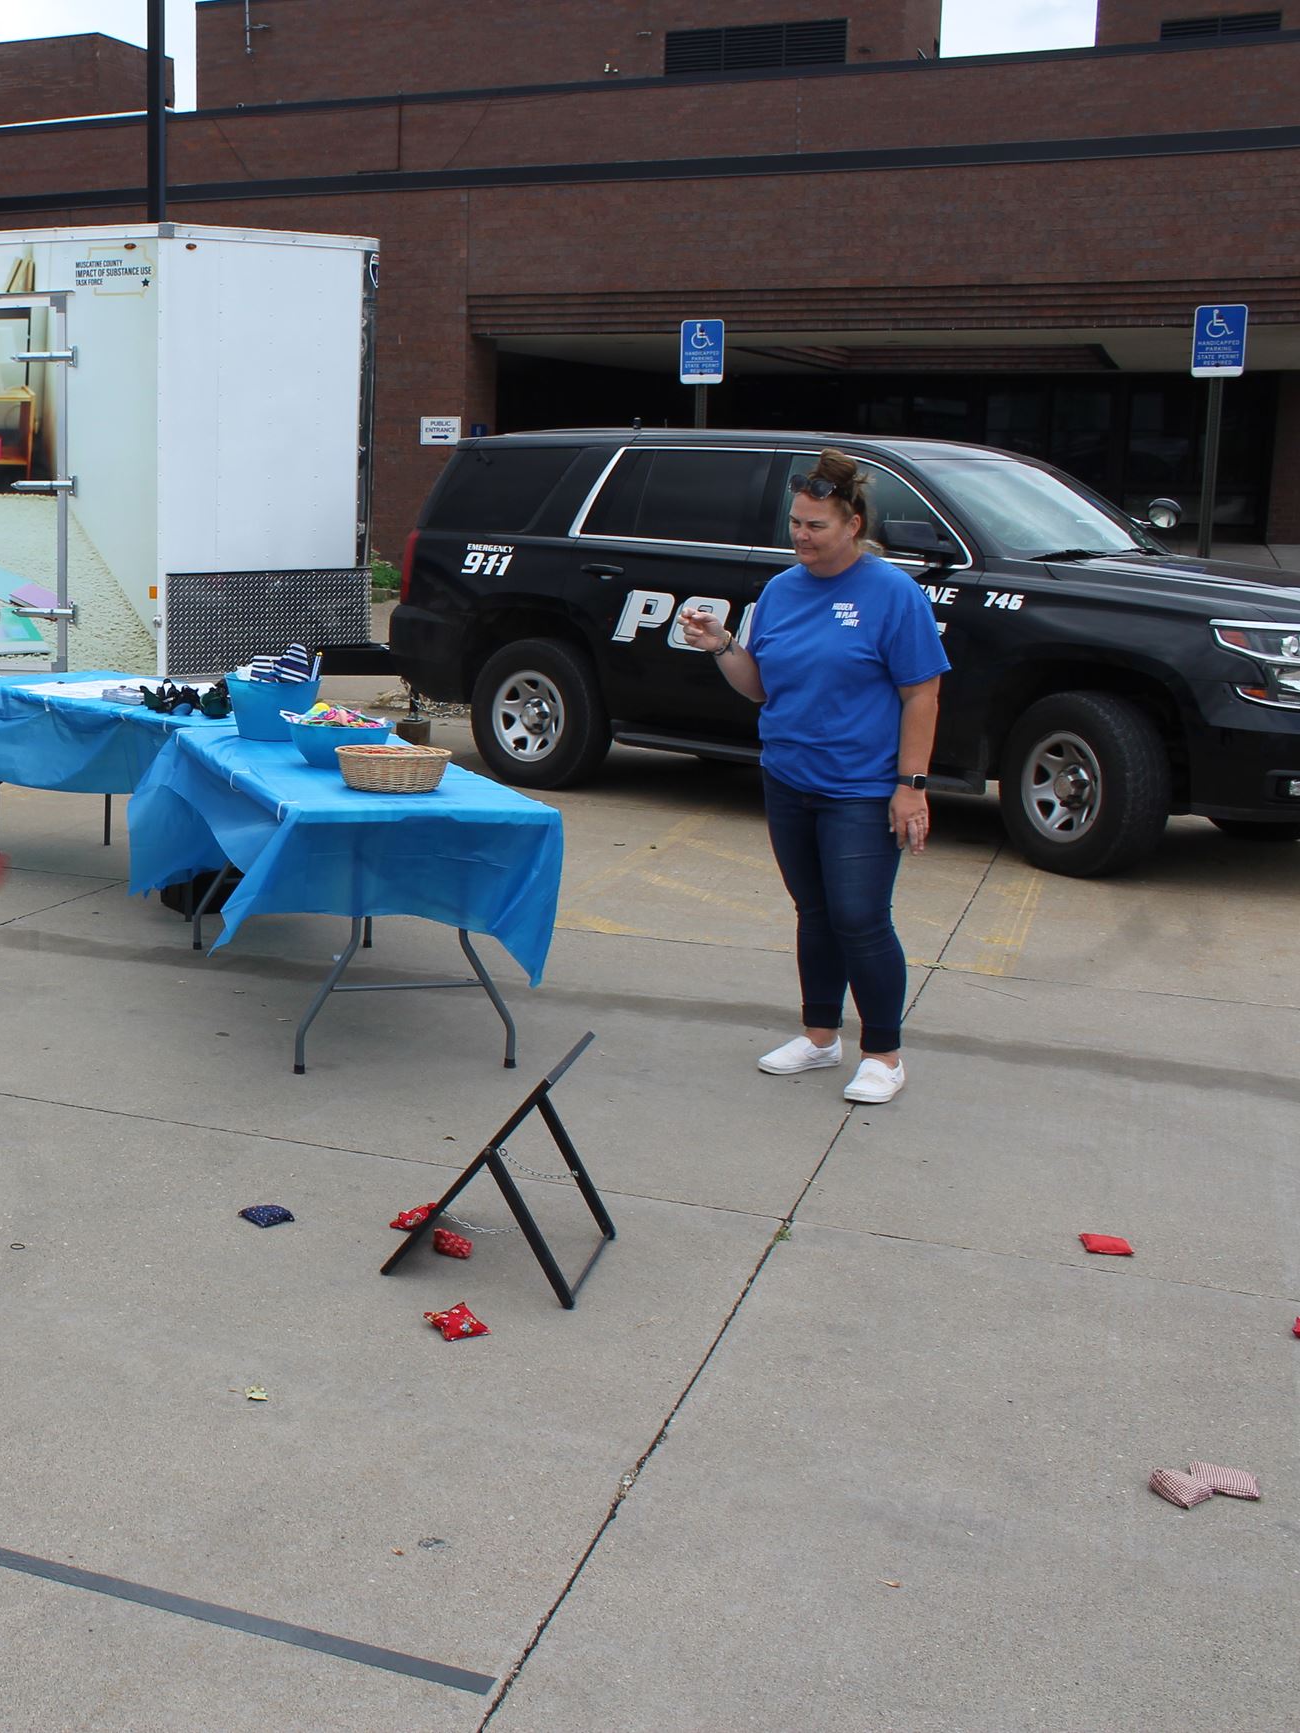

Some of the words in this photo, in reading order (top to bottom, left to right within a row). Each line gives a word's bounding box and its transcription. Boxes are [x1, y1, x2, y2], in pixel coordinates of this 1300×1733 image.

[75, 268, 97, 278] IMPACT
[98, 268, 106, 277] OF
[106, 267, 140, 276] SUBSTANCE
[140, 266, 152, 275] USE
[466, 543, 515, 553] EMERGENCY
[983, 591, 1025, 612] 746
